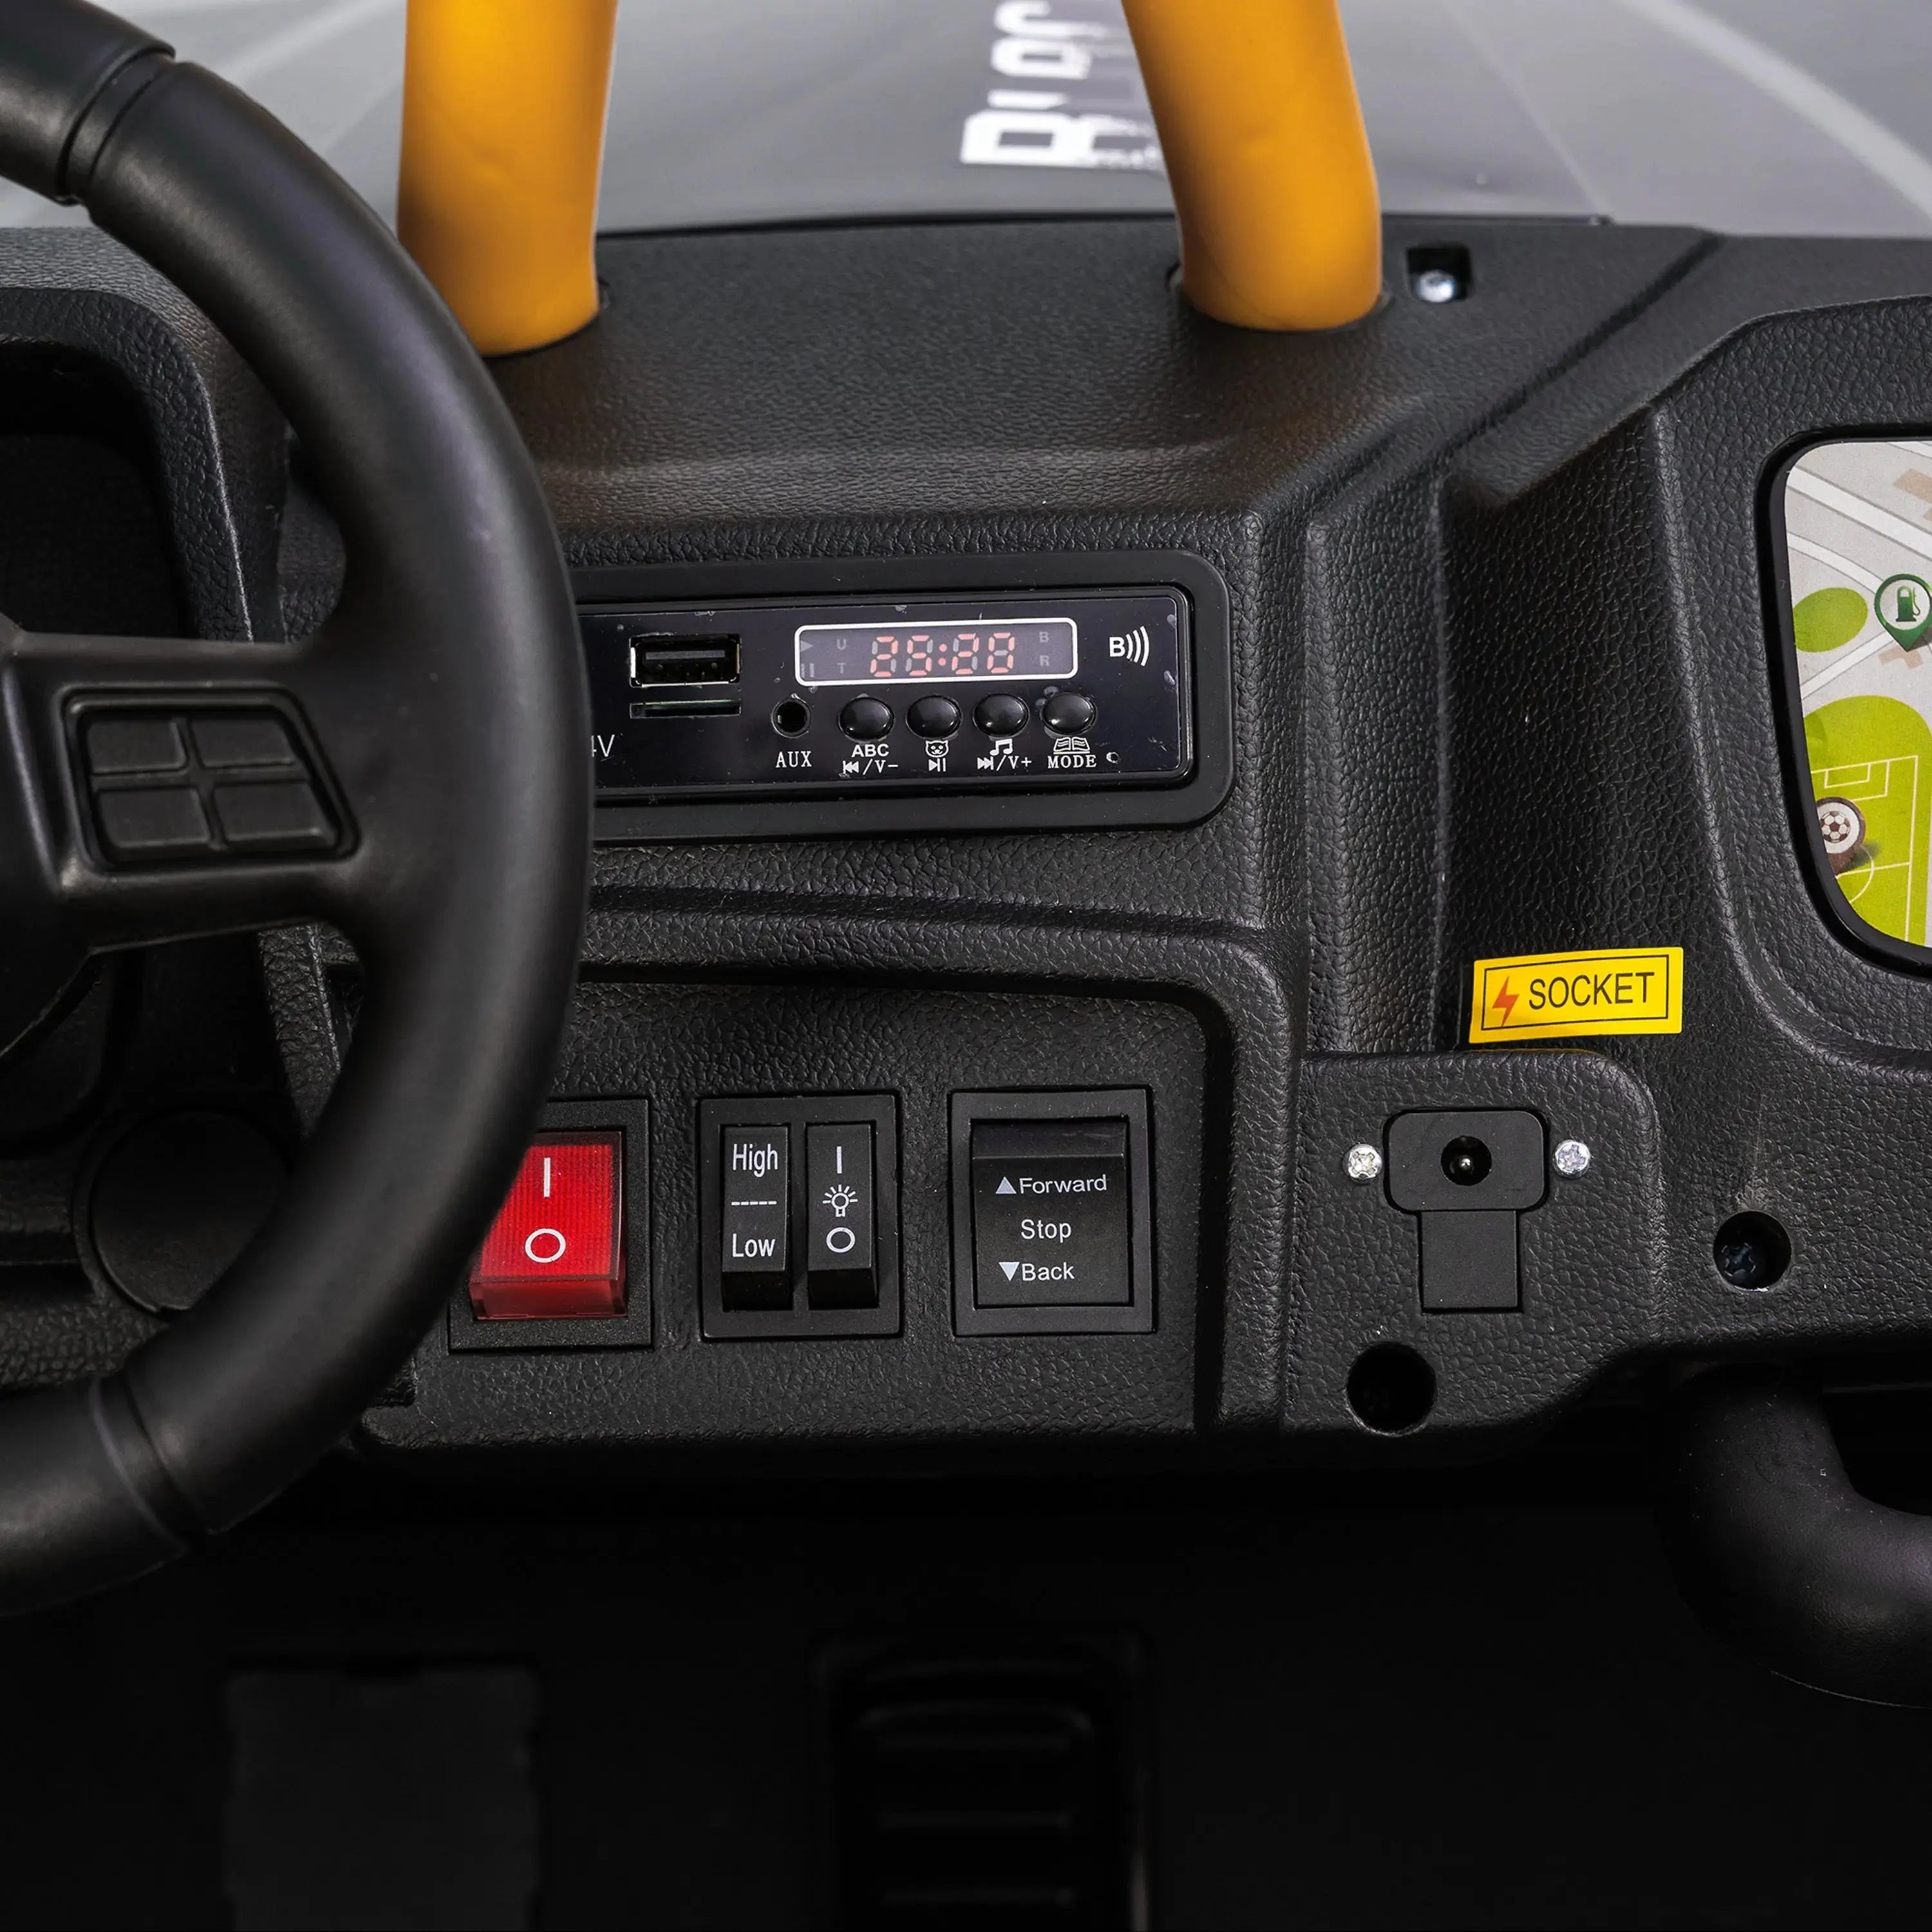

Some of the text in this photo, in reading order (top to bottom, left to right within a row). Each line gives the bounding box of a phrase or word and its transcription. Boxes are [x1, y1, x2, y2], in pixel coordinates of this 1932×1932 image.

[837, 638, 847, 650] U
[1038, 631, 1050, 643] B
[1039, 655, 1050, 667] R
[775, 750, 812, 768] AUX
[851, 744, 889, 758] ABC
[1047, 754, 1097, 769] MODE
[1528, 971, 1655, 1010] SOCKET
[732, 1143, 779, 1178] High
[1019, 1173, 1108, 1194] Forward
[1020, 1218, 1072, 1244] Stop
[731, 1233, 776, 1258] Low
[1021, 1261, 1075, 1282] Back
